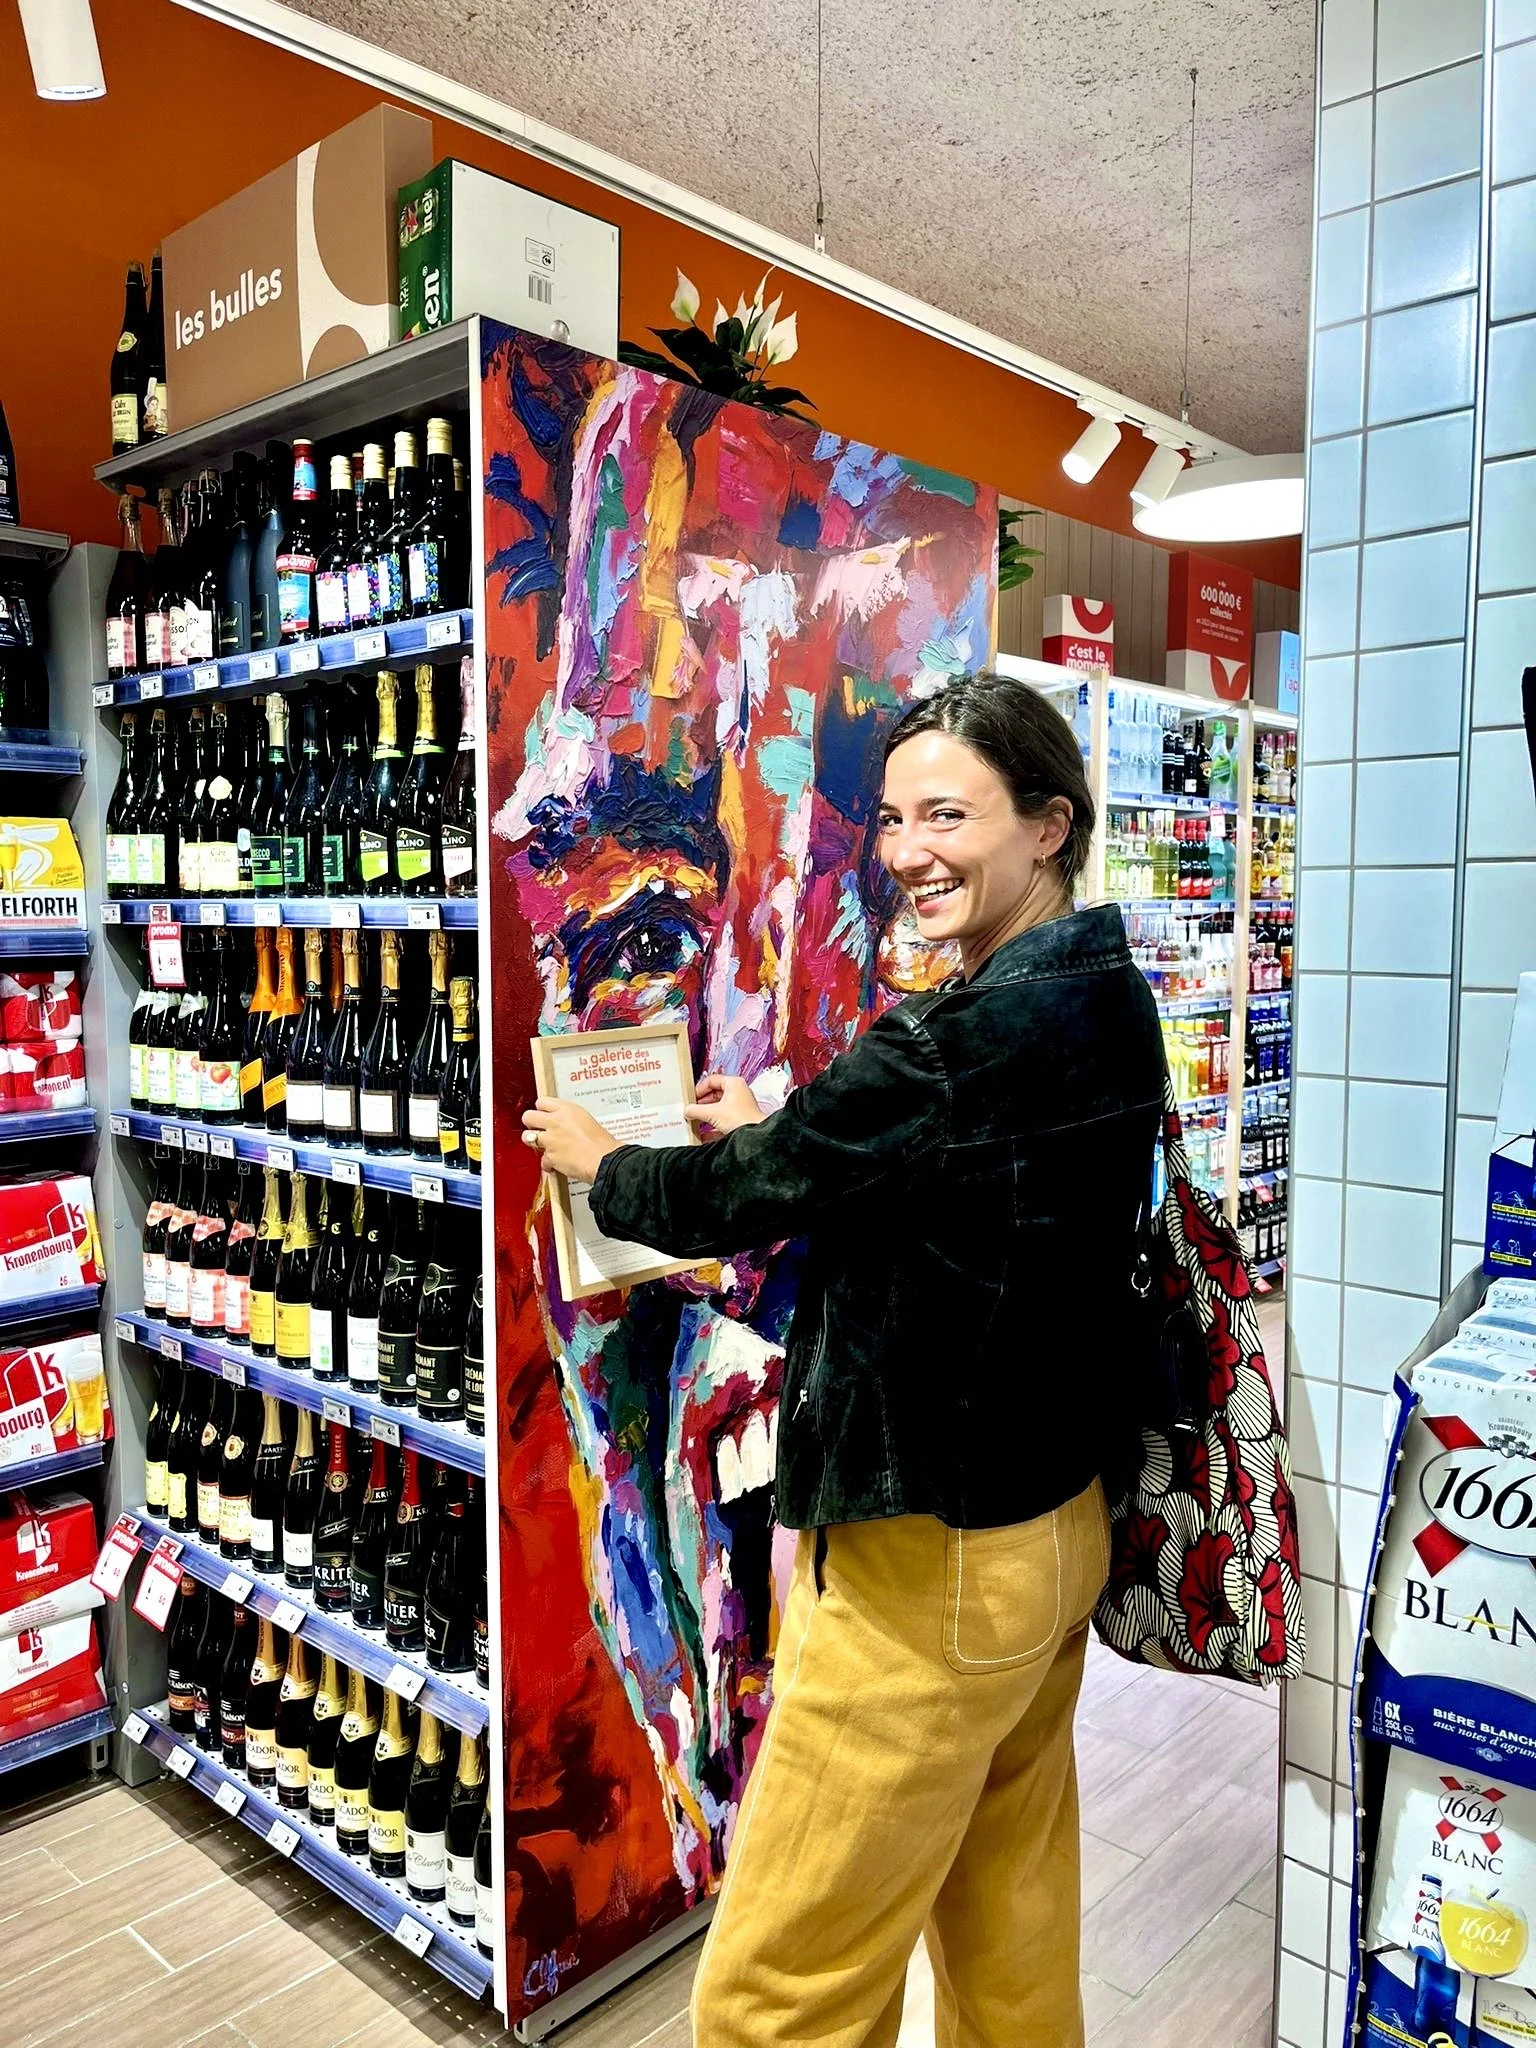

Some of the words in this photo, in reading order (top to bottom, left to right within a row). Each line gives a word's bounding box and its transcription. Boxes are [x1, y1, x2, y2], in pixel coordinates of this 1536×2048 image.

[175, 309, 205, 350] les
[209, 267, 283, 331] bulles
[424, 268, 440, 330] en
[1200, 584, 1218, 603] 600
[1219, 590, 1235, 609] 000
[1236, 596, 1242, 611] €
[1068, 642, 1093, 660] c'est
[1095, 646, 1106, 661] le
[1, 896, 79, 917] ELFORTH
[151, 925, 178, 939] promo
[579, 1056, 588, 1066] la
[590, 1047, 633, 1067] galerie
[634, 1049, 650, 1059] des
[570, 1066, 618, 1082] artistes
[620, 1058, 661, 1075] voisins
[4, 1239, 73, 1271] Kronenbourg
[1418, 1374, 1498, 1396] ORIGINE
[334, 1434, 342, 1464] KRITER
[1433, 1465, 1536, 1530] 166
[1384, 1701, 1401, 1721] 6X
[1433, 1707, 1475, 1730] BIÈRE
[1372, 1724, 1385, 1735] ALC.
[1385, 1719, 1402, 1732] 25CL
[1433, 1720, 1456, 1733] aux
[1458, 1726, 1488, 1743] notes
[1444, 1796, 1498, 1827] 1664
[1432, 1839, 1504, 1875] BLANC
[1458, 1916, 1513, 1946] 1664
[1461, 1940, 1503, 1958] BLANC
